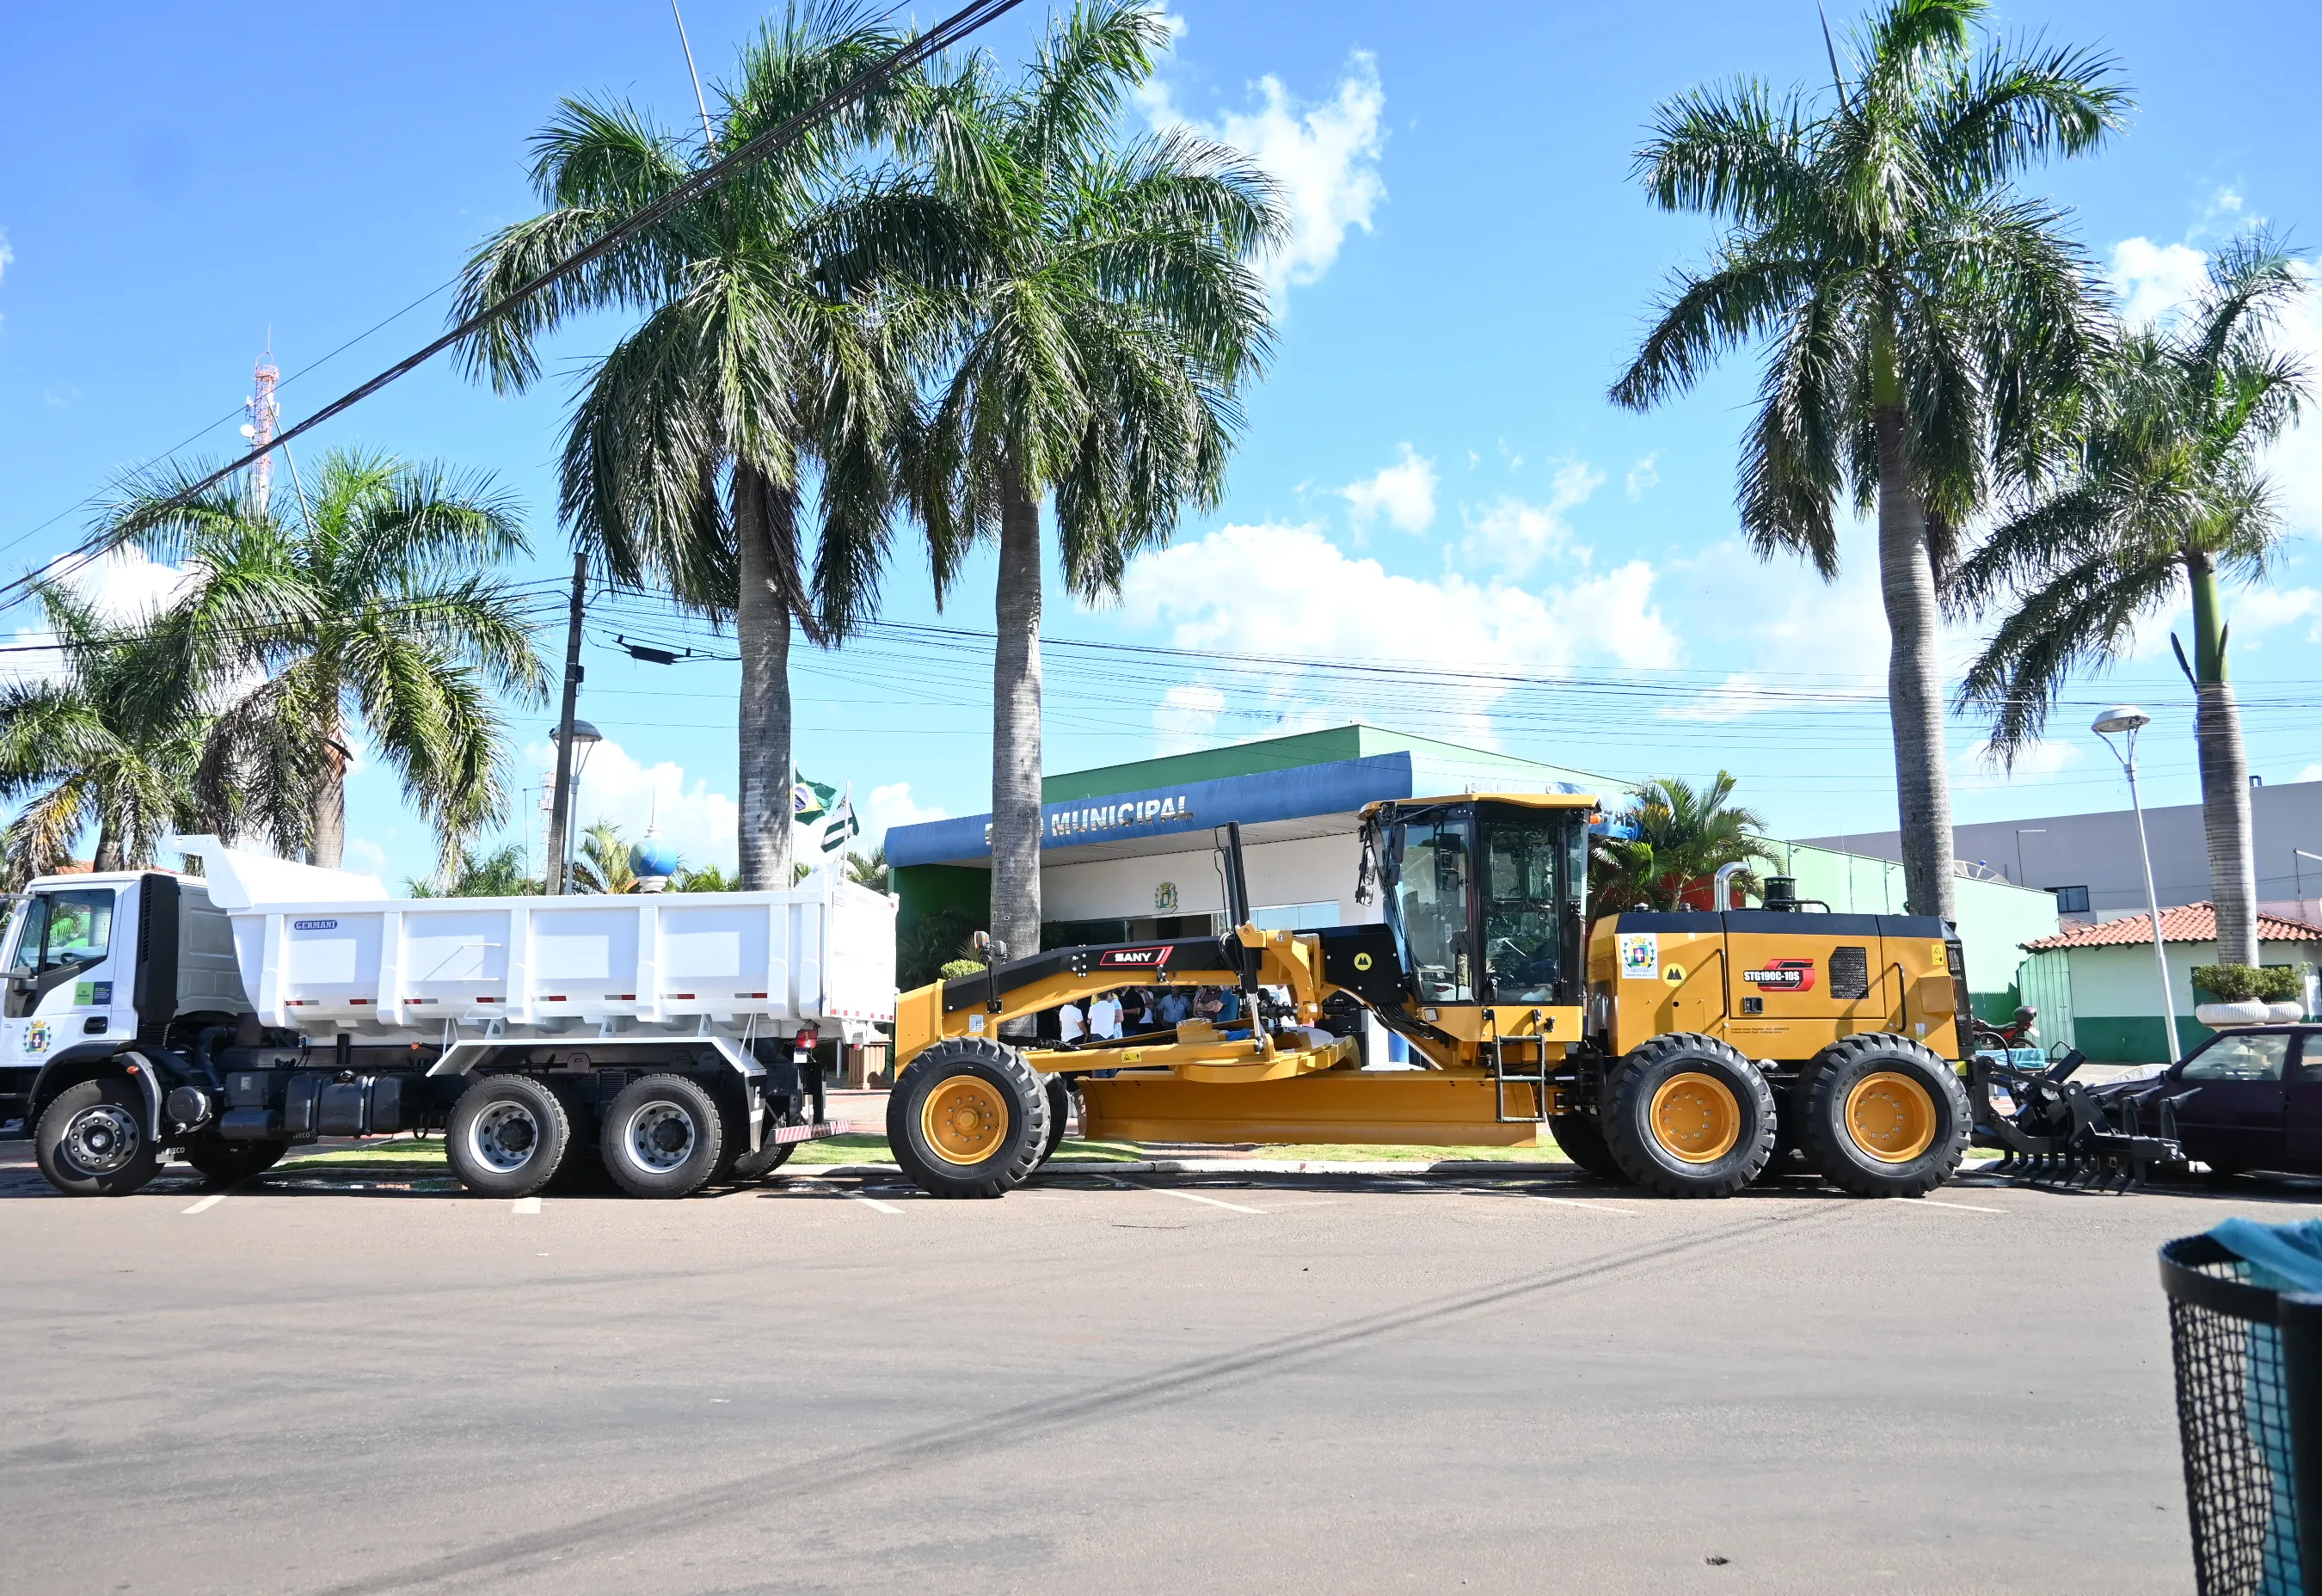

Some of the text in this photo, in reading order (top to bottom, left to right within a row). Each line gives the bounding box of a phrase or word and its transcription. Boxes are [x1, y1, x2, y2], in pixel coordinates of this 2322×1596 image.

[1052, 796, 1194, 837] MUNICIPAL
[1115, 953, 1152, 962] SANY
[1743, 971, 1800, 981] STG190C-10S
